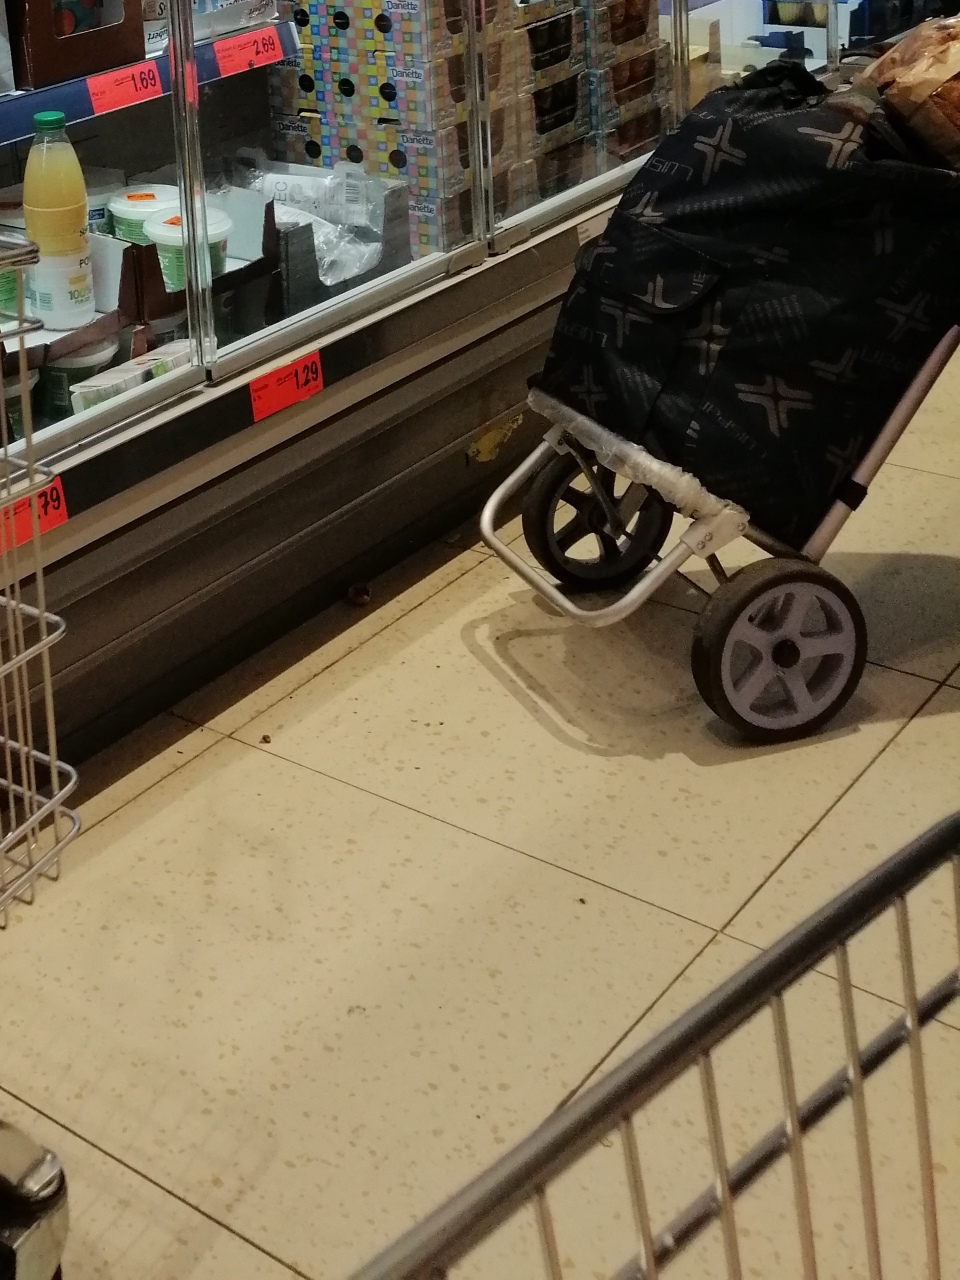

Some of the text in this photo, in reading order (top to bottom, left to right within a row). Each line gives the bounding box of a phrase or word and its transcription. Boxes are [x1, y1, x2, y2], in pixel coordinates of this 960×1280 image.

[386, 1, 418, 12] Danette
[147, 28, 168, 41] ubert
[252, 35, 276, 57] 2.69
[131, 68, 157, 93] 1.69
[391, 69, 423, 80] Danette
[278, 122, 308, 133] Danette
[401, 135, 434, 147] Danette
[273, 181, 287, 206] EC
[409, 203, 435, 215] anette
[293, 360, 319, 391] 1.29
[29, 487, 62, 520] .79
